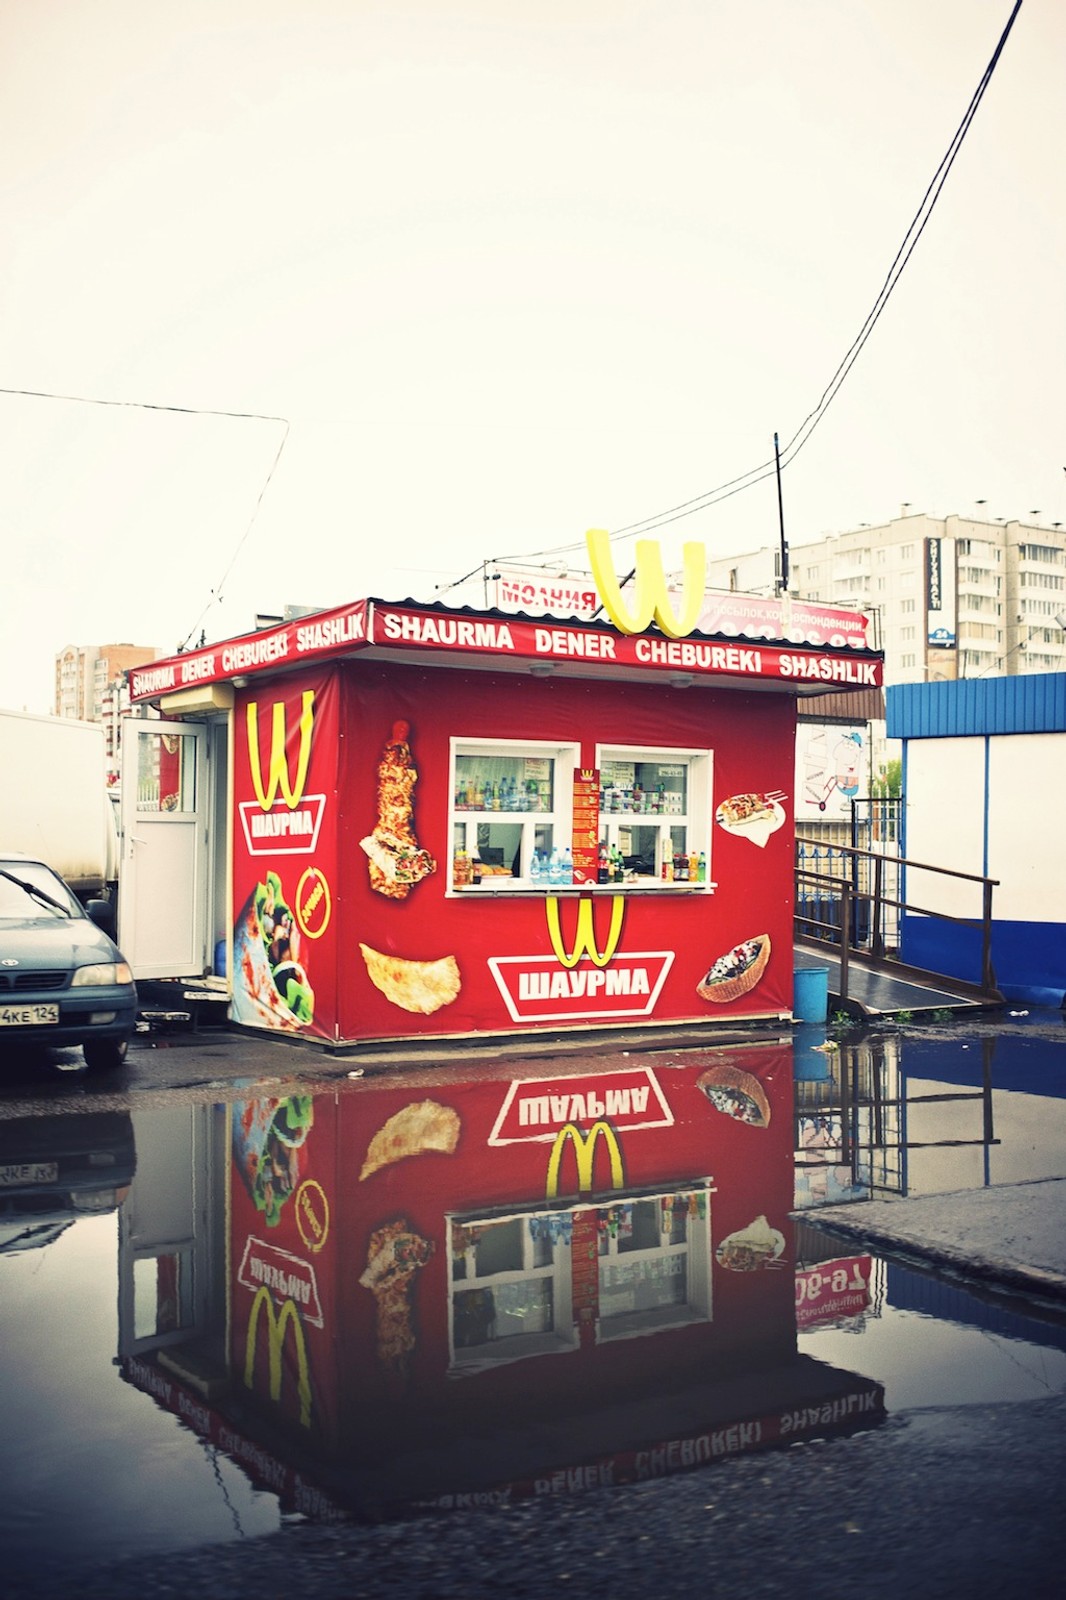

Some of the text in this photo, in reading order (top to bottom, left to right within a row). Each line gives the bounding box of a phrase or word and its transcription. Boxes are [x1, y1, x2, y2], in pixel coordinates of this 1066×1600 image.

[502, 582, 596, 612] МОЛНИЯ
[132, 612, 365, 697] SHAURMA DENER CHEBUREKI SHASHLIK
[383, 614, 878, 686] SHAURMA DENER CHEBUREKI SHASHLIK
[251, 809, 314, 839] ШАУРМА
[518, 968, 651, 1001] ШАУРМА
[33, 1007, 57, 1018] 124
